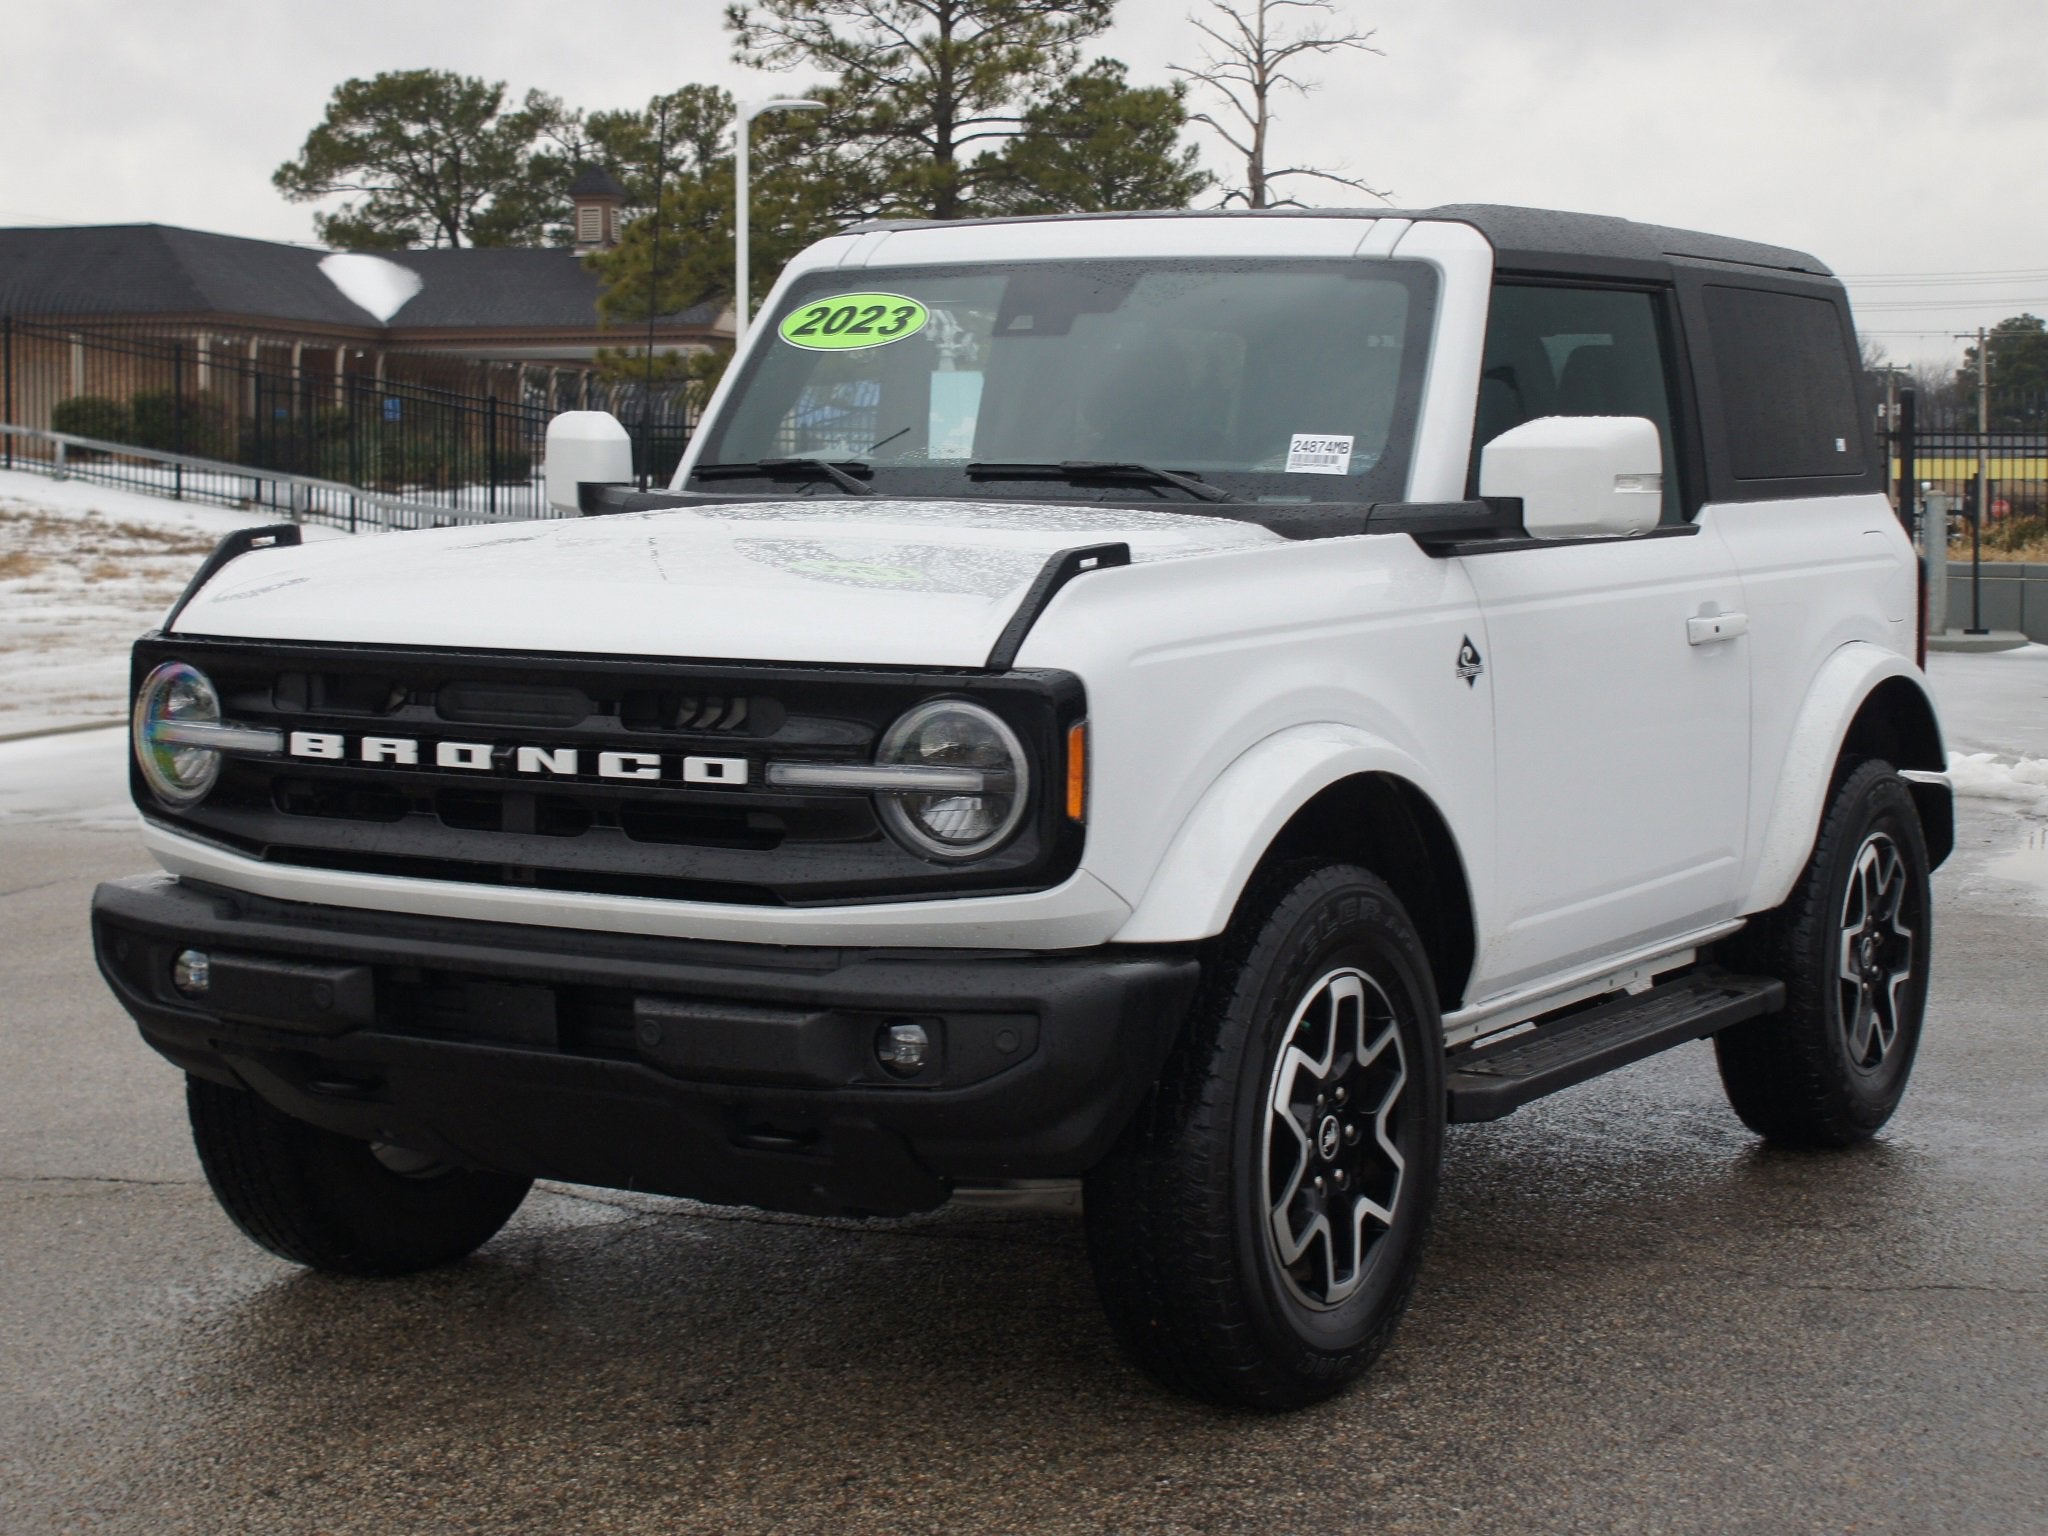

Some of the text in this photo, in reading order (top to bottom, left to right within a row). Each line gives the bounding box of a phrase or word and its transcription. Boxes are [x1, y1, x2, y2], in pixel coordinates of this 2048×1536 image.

[790, 305, 916, 337] 2023
[1292, 440, 1350, 454] 24874MB
[290, 731, 748, 785] BRONCO
